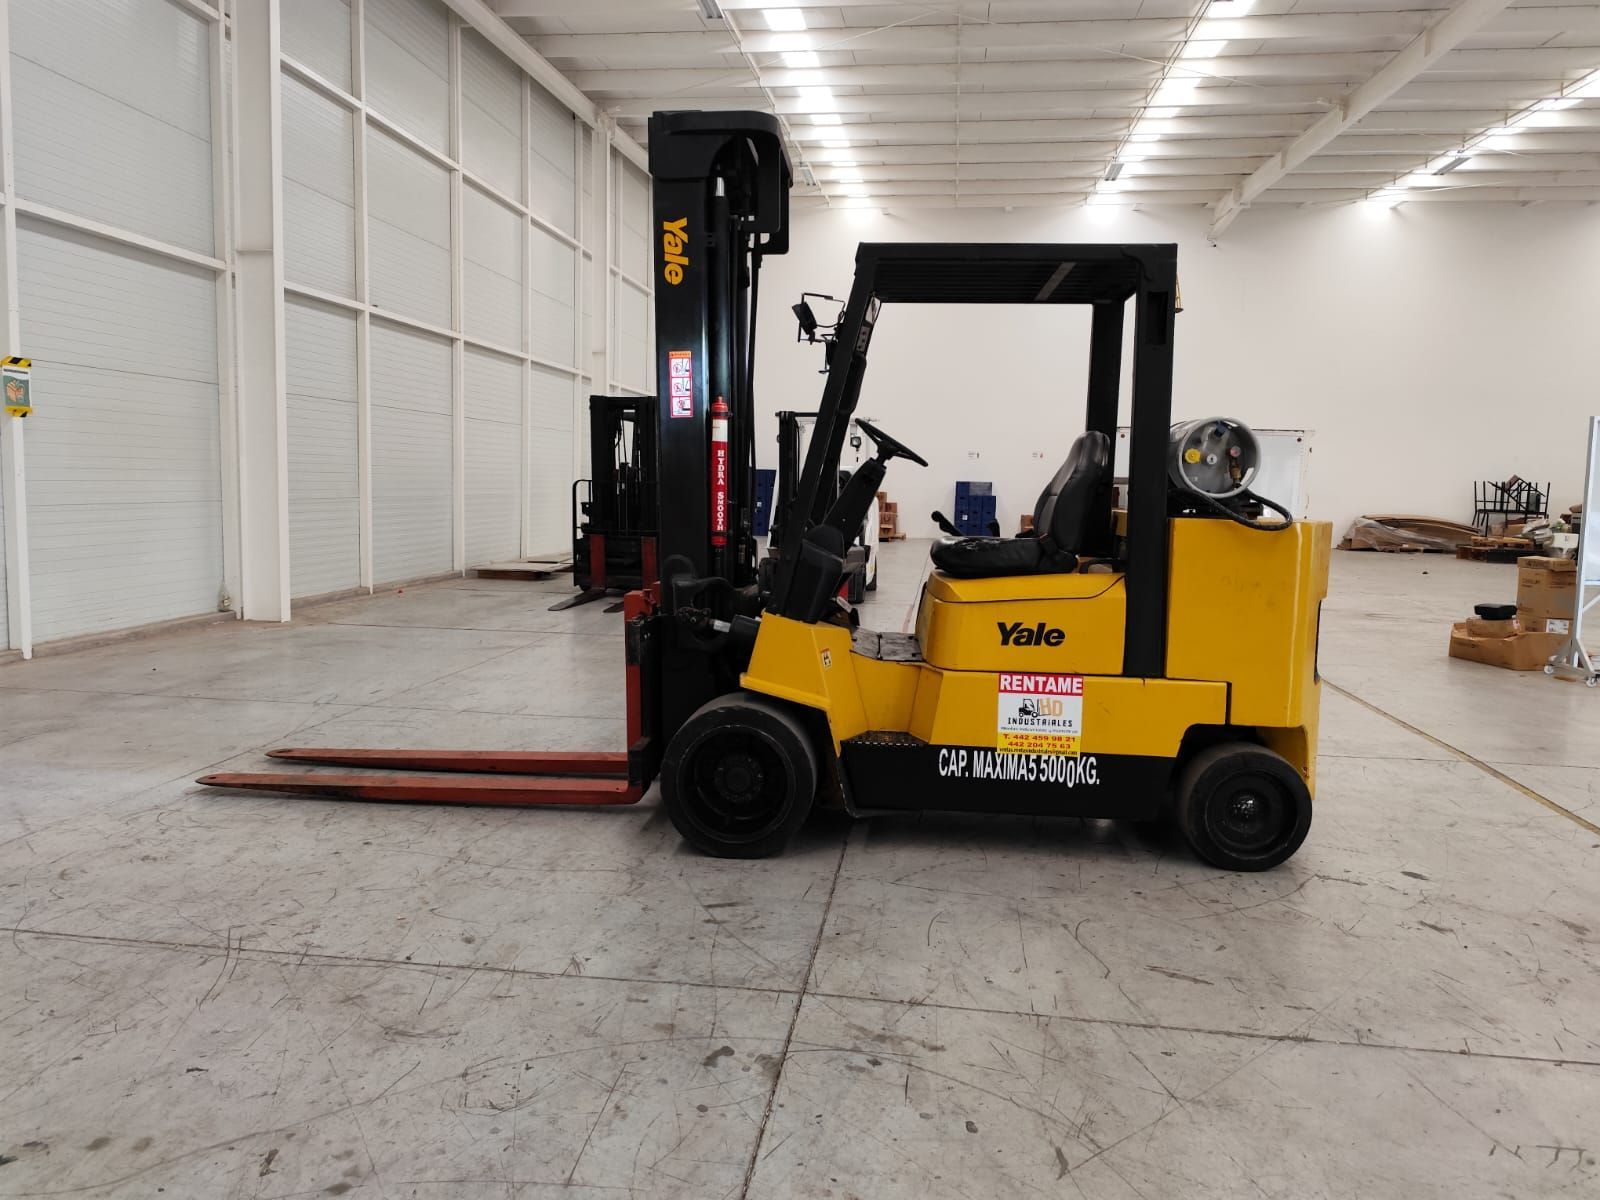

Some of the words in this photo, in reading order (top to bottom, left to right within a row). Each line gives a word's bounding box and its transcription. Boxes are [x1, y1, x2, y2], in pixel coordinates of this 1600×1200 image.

[663, 217, 689, 286] Yale
[716, 491, 725, 531] SMOOTH
[997, 622, 1066, 647] Yale
[1000, 674, 1083, 694] RENTAME
[938, 748, 969, 777] CAP.
